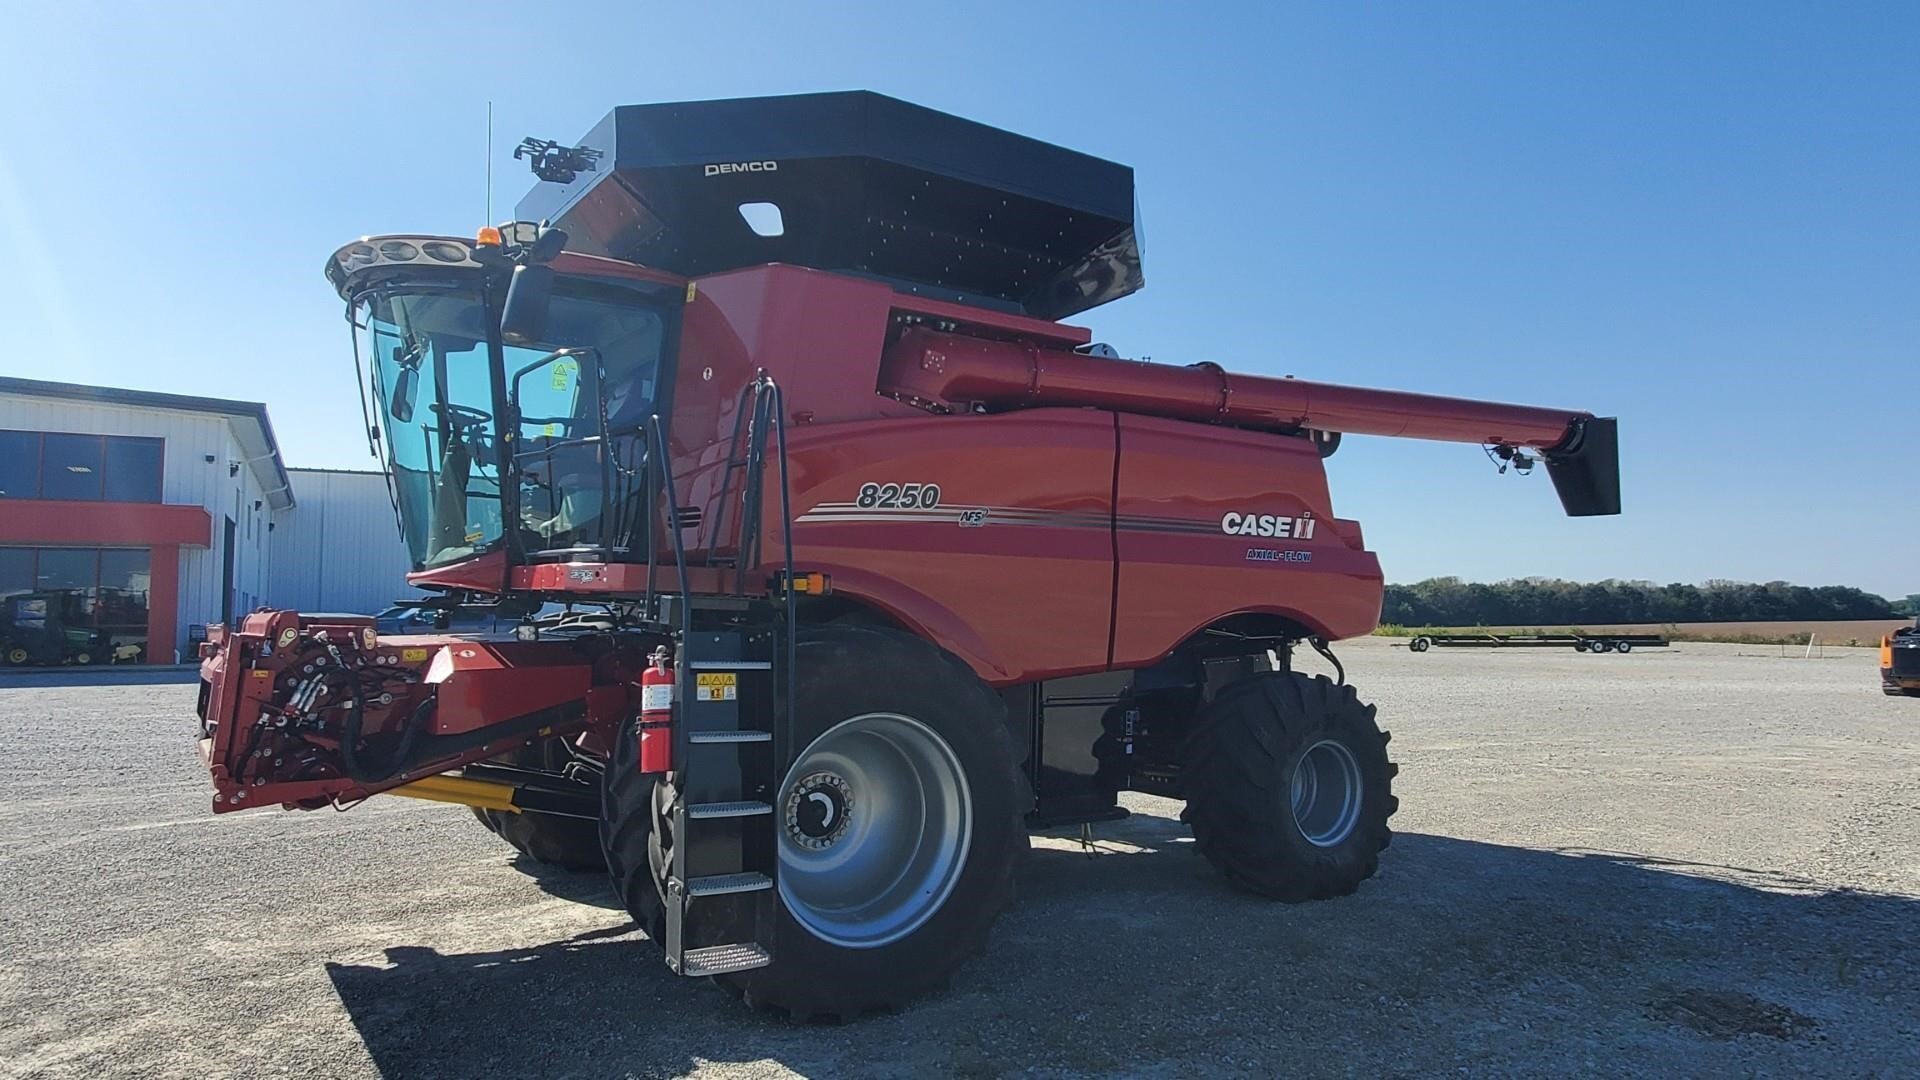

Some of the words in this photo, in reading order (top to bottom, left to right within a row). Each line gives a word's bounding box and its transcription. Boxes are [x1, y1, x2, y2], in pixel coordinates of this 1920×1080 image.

[704, 161, 777, 176] DEMCO
[856, 482, 941, 511] 8250
[960, 511, 983, 522] AFS
[1222, 512, 1292, 538] CASE
[1246, 549, 1312, 563] AXIAL-FLOW
